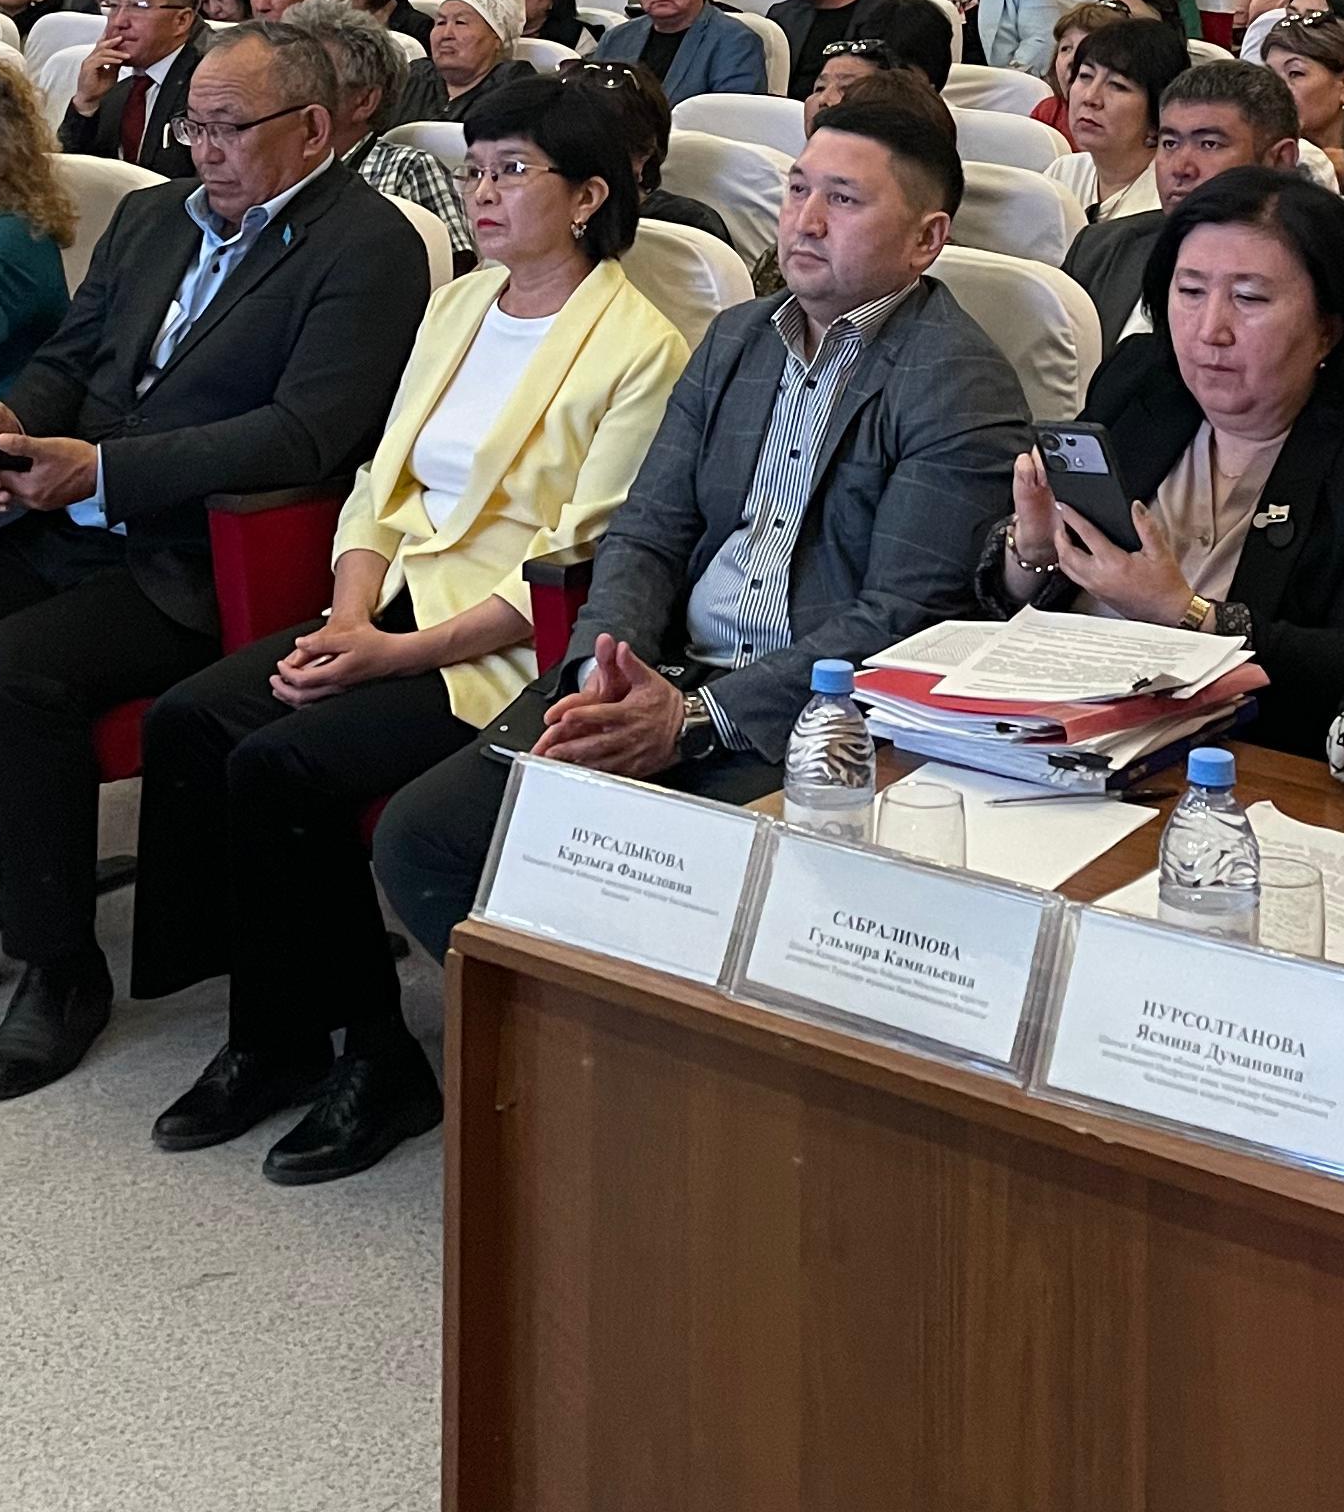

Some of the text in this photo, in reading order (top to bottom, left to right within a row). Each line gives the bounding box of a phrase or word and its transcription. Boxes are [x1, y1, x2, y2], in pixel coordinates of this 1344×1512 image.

[571, 826, 684, 871] НУРСАДЫКОВА
[618, 862, 692, 895] Фазыловна
[809, 926, 880, 960] Гульмира
[884, 949, 975, 989] Камильевна
[832, 910, 960, 960] САБРАЛИМОВА
[1136, 1023, 1202, 1055] Ясмина
[1205, 1042, 1304, 1082] Думановна
[1142, 999, 1306, 1058] НУРСОЛТАНОВА
